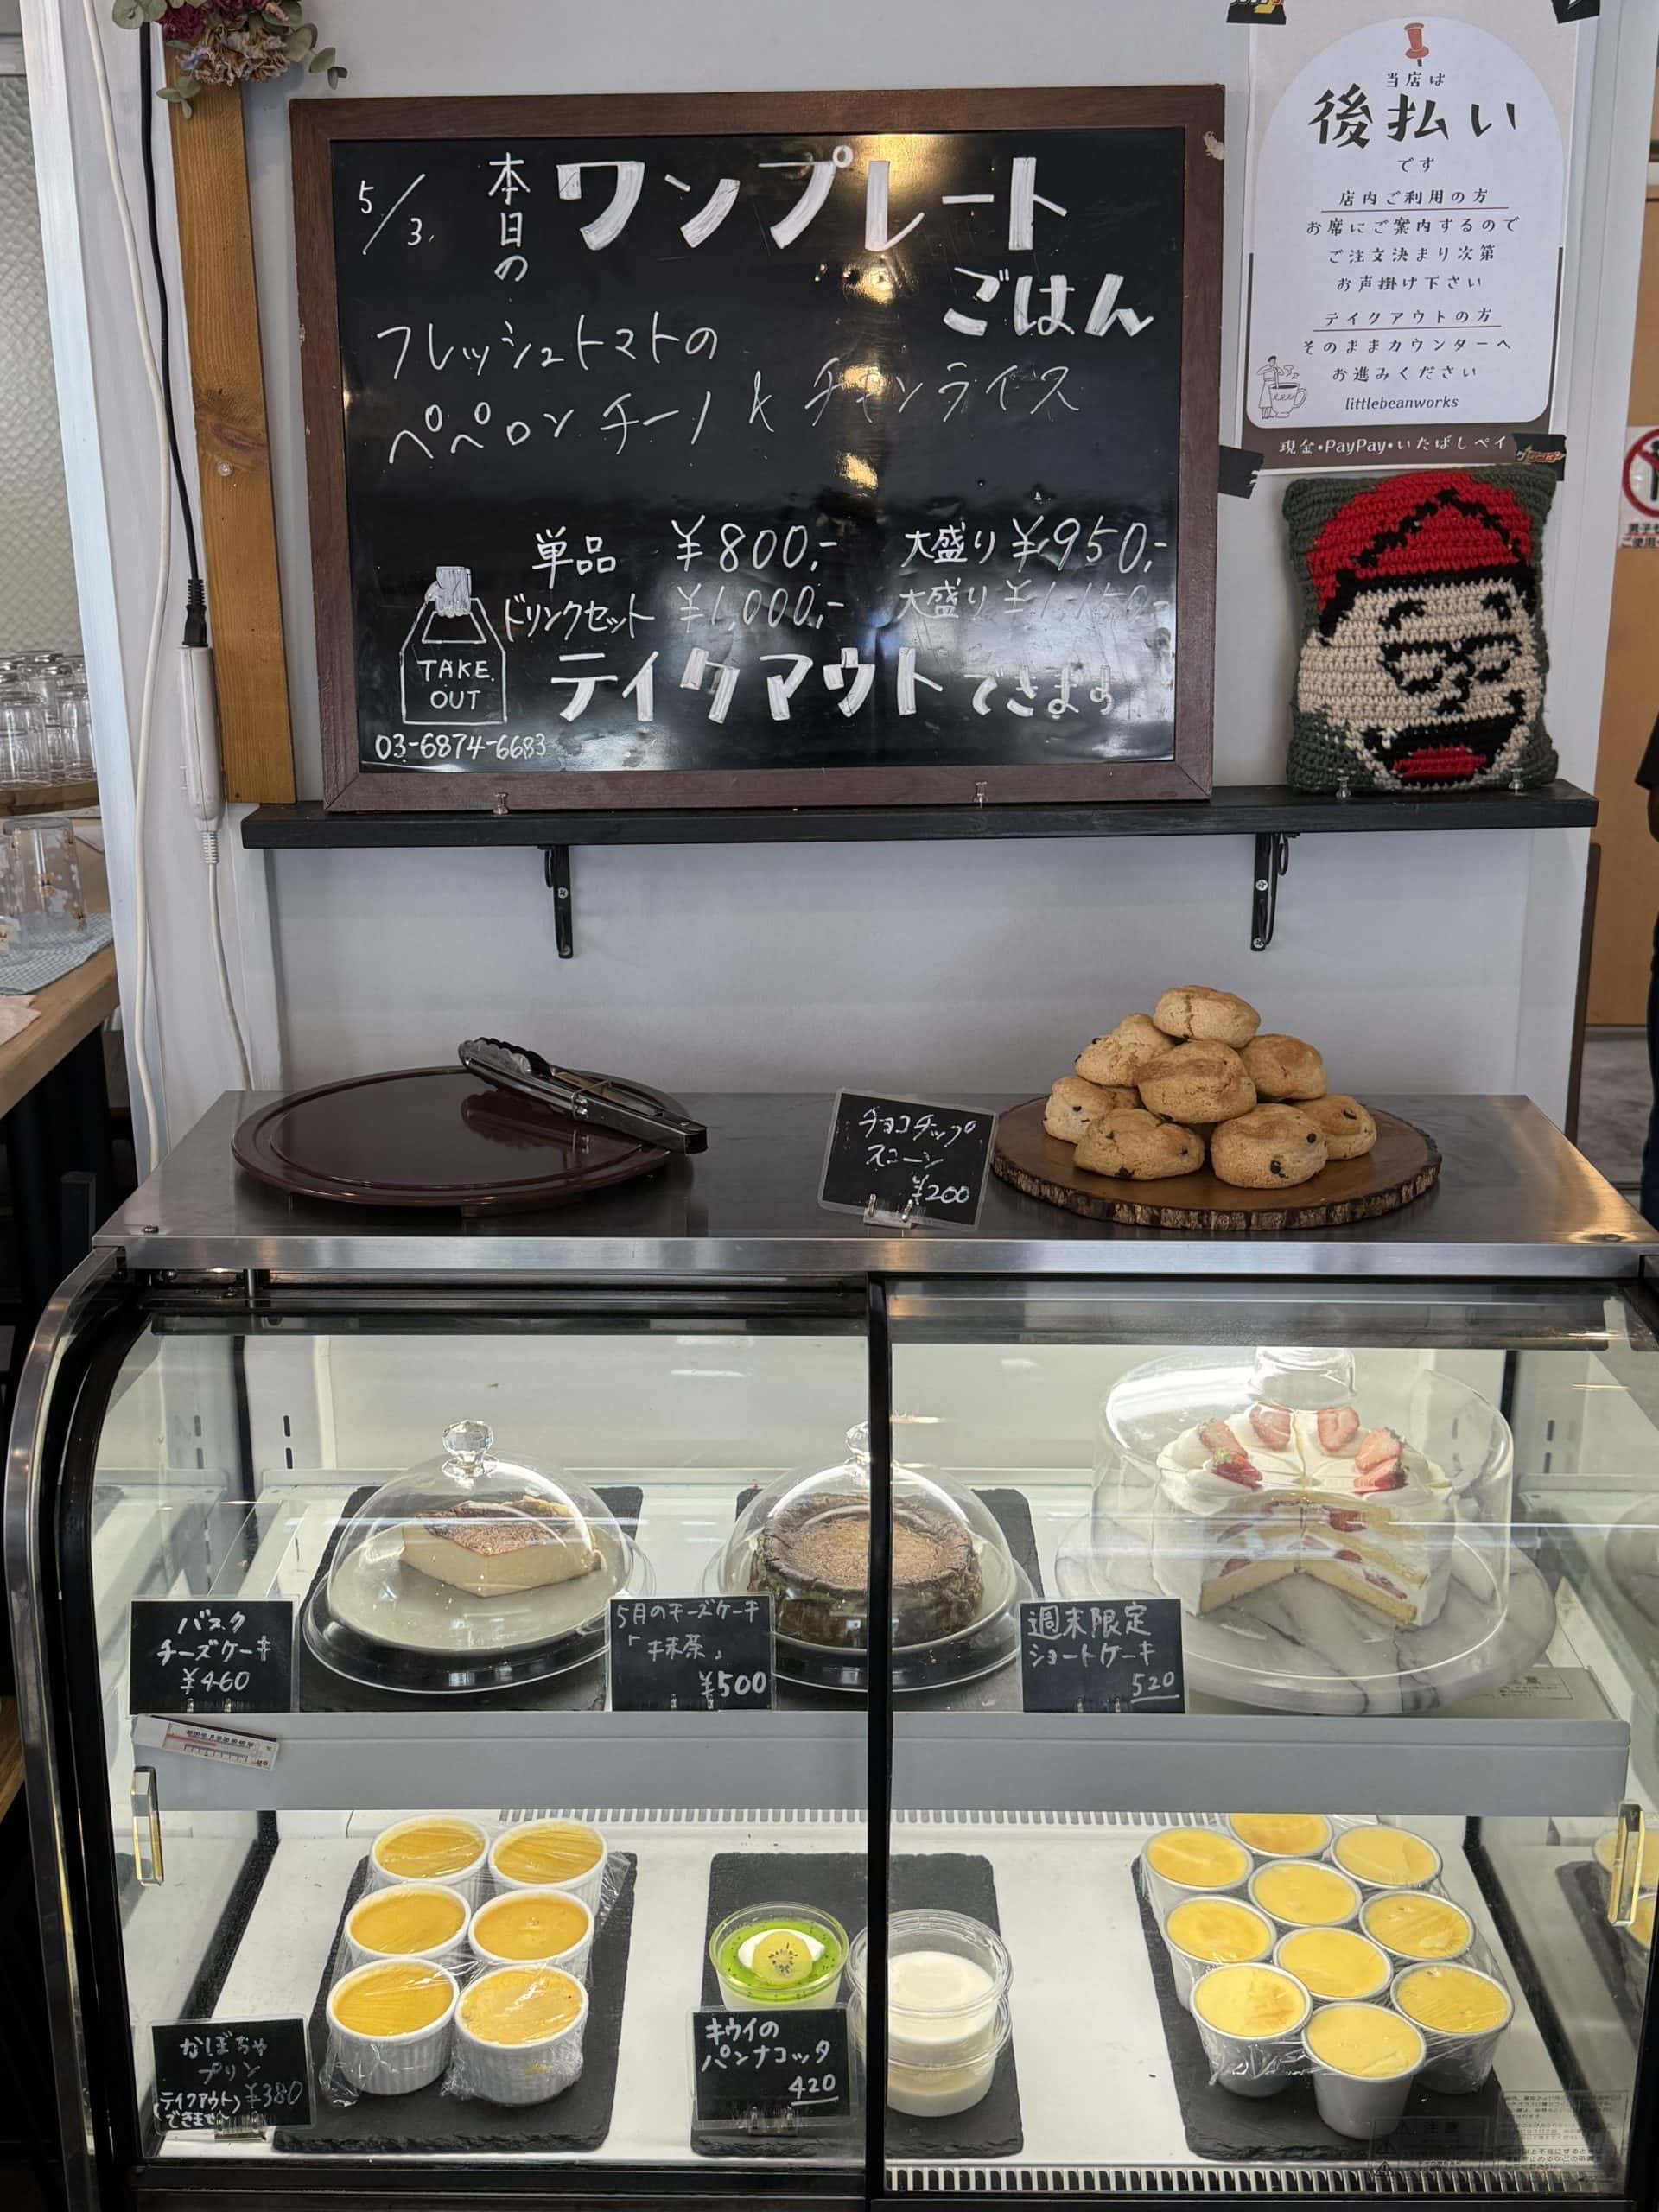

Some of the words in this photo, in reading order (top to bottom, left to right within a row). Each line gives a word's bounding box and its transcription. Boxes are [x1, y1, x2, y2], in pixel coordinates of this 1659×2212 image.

[1386, 71, 1446, 88] 当店は
[1307, 83, 1516, 149] 後払い
[1397, 156, 1435, 173] です
[556, 145, 1067, 251] ワンプレート
[1339, 188, 1488, 207] 店内ご利用の方
[488, 152, 531, 281] 本日の
[1306, 216, 1521, 237] お席にご案内するので
[1328, 244, 1496, 264] ご注文決まり次第
[1337, 275, 1482, 292] お声掛け下さい
[944, 267, 1154, 337] ごはん
[1325, 308, 1492, 326] テイクアウトの方
[378, 312, 718, 379] フレッシュトマトの
[1303, 338, 1511, 355] そのままカウンターへ
[1332, 365, 1477, 382] お進みください
[1345, 396, 1459, 410] littlebeanworks
[532, 526, 617, 589] 単品
[901, 522, 995, 567] 大盛り
[505, 593, 655, 642] ドリンクセット
[897, 577, 988, 620] 大盛り
[550, 647, 943, 724] テイクアウト
[429, 690, 481, 710] OUT
[375, 733, 547, 760] 03-6874-6683
[859, 1106, 976, 1147] チョコチップ
[866, 1144, 944, 1169] スコーン
[912, 1175, 969, 1205] ¥200
[177, 1609, 245, 1634] バスク
[1027, 1602, 1152, 1640] 週末限定
[156, 1636, 272, 1666] チーズケーキ
[1030, 1641, 1157, 1668] ショートケーキ
[181, 1667, 250, 1694] ¥460
[699, 1670, 766, 1700] ¥500
[1133, 1671, 1175, 1697] 520
[180, 2031, 268, 2059] かぼちゃ
[705, 2018, 779, 2045] キウイの
[701, 2039, 830, 2072] パンナコッタ
[198, 2062, 261, 2085] プリン
[788, 2074, 836, 2100] 420
[245, 2081, 303, 2108] ¥380
